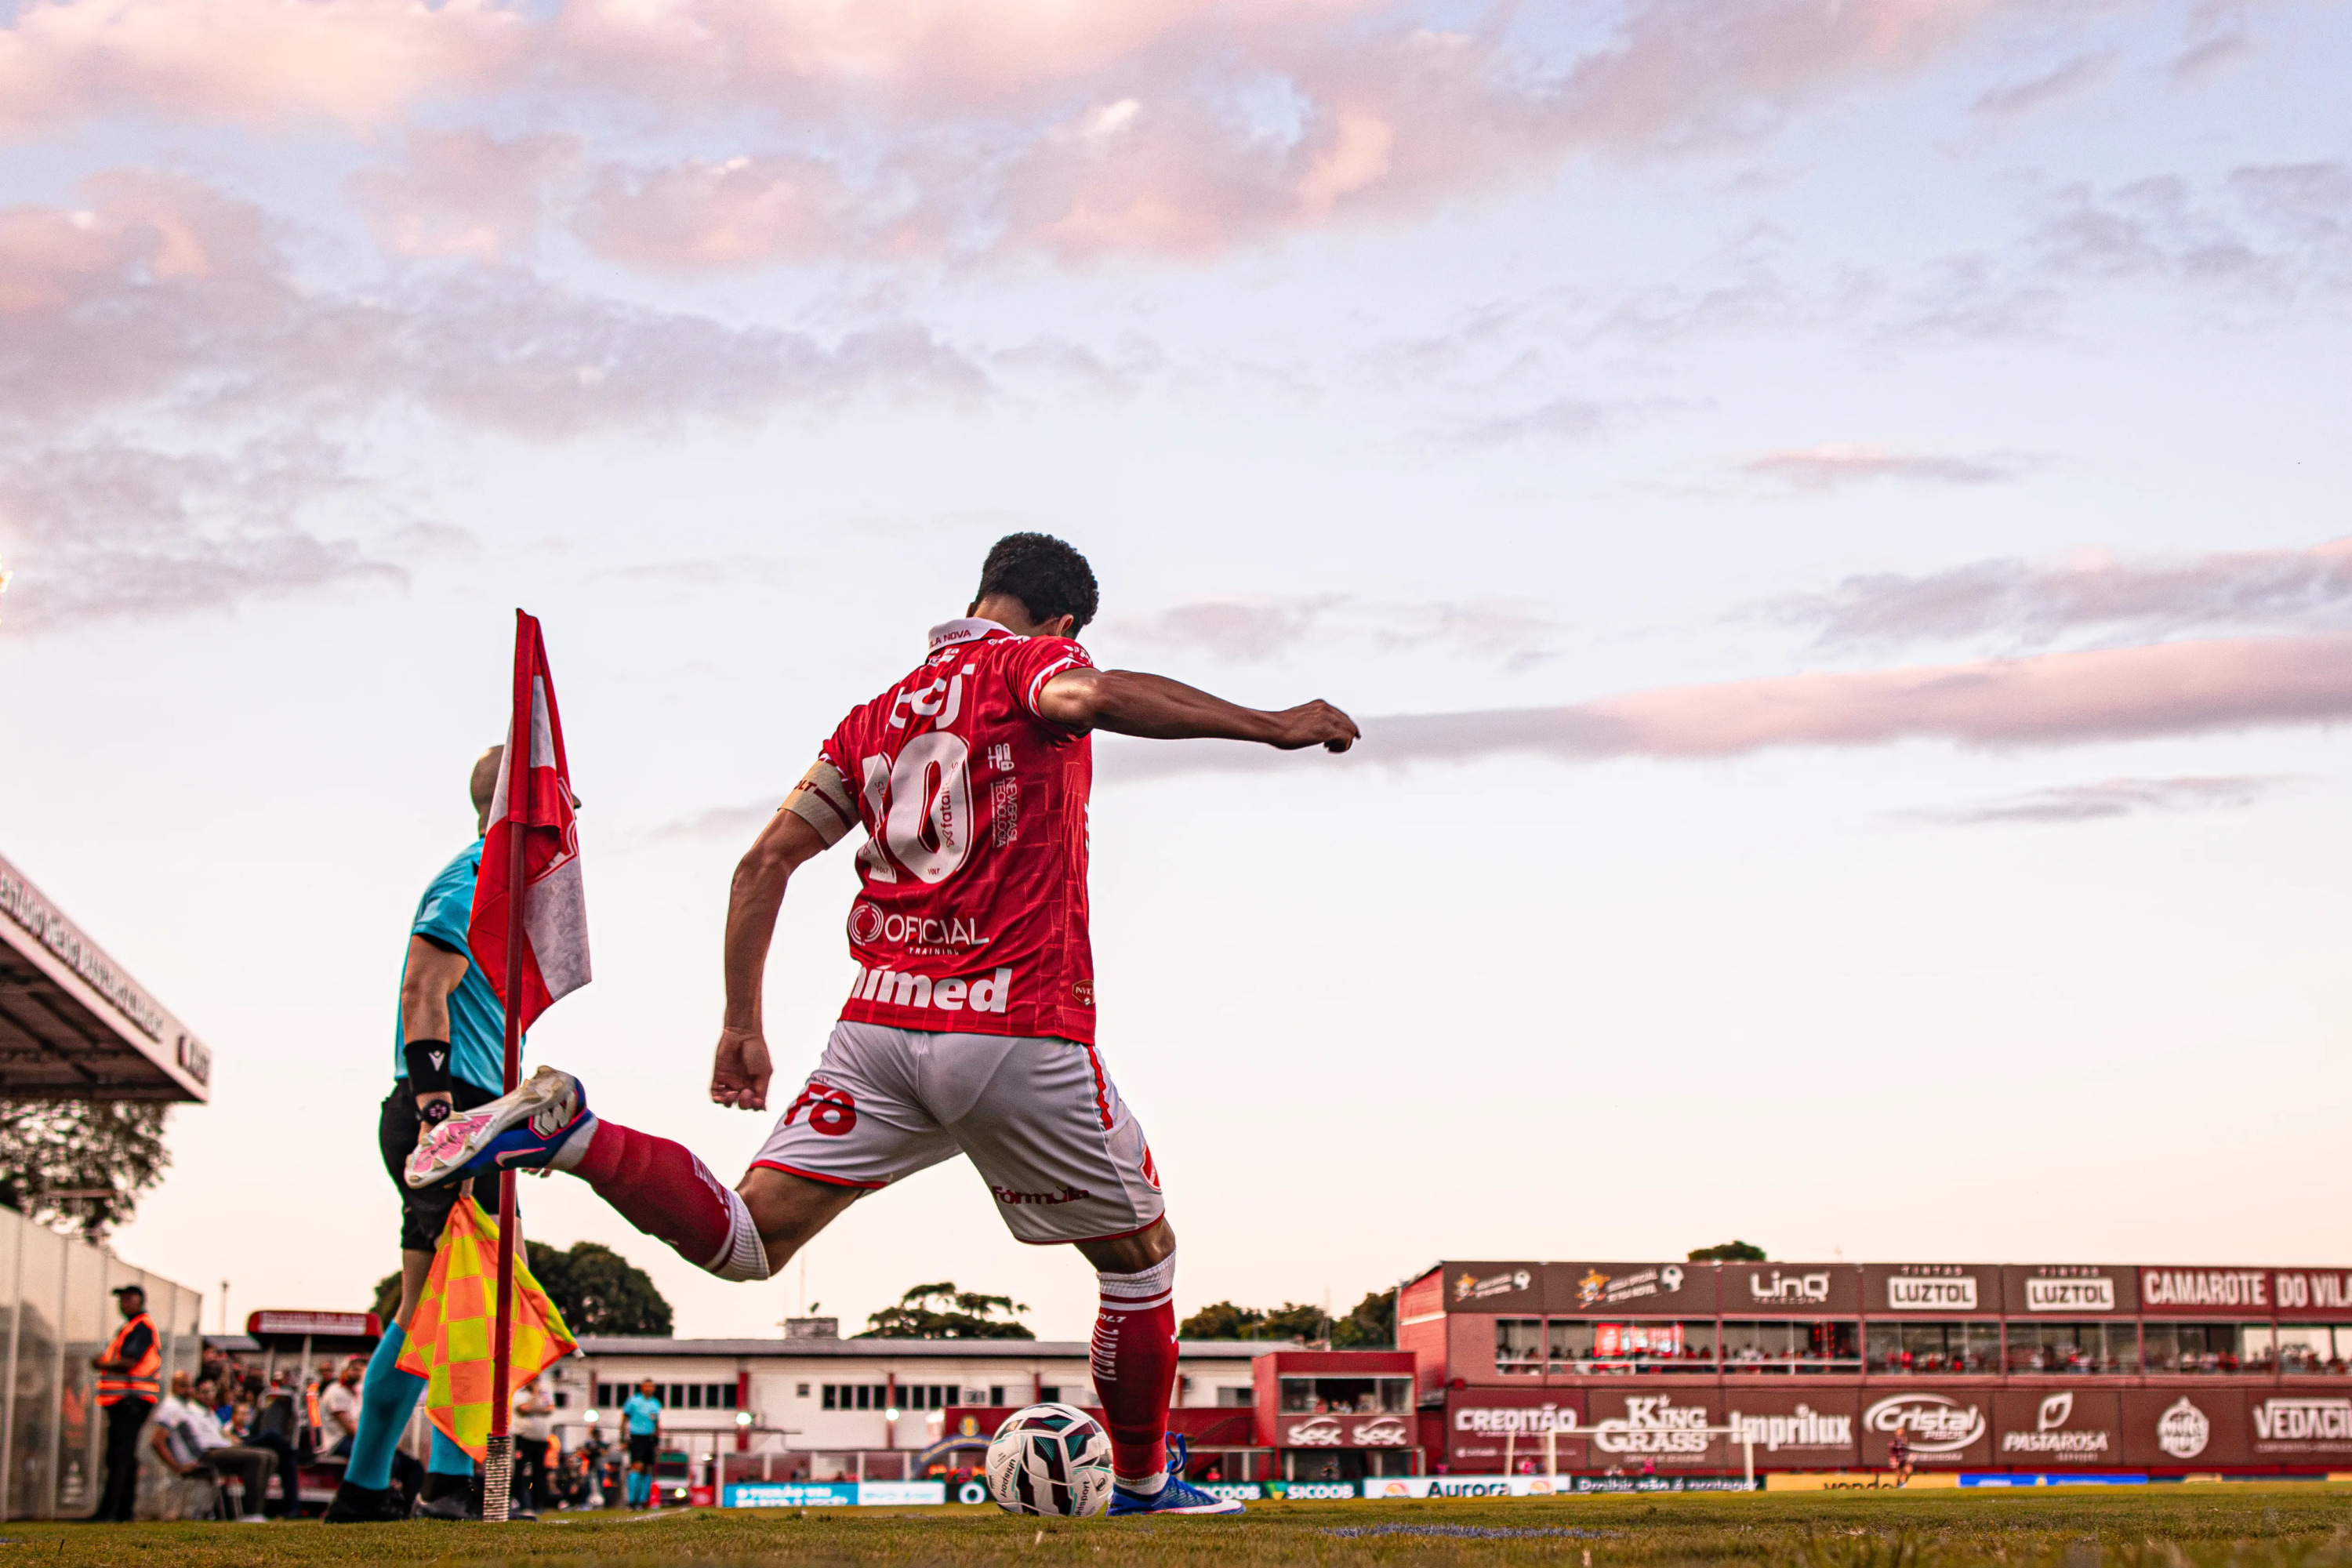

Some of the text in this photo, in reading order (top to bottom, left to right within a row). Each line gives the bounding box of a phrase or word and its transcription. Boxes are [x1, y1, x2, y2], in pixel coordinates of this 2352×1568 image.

[943, 629, 971, 642] NOVA
[884, 913, 990, 946] OFICIAL
[908, 946, 960, 956] TRAINING
[1894, 1283, 1972, 1303] LUZTOL
[2032, 1285, 2110, 1305] LUZTOL
[2143, 1269, 2269, 1306] CAMAROTE
[2276, 1272, 2309, 1308] DO
[1454, 1402, 1577, 1432] CREDITÃO
[1875, 1404, 1978, 1432] Cristal
[1287, 1417, 1343, 1446] Sesc
[1352, 1417, 1407, 1446] Sesc
[2002, 1429, 2109, 1452] PASTAROSA
[1000, 1458, 1017, 1498] uhlsport
[1287, 1484, 1355, 1500] SICOOB
